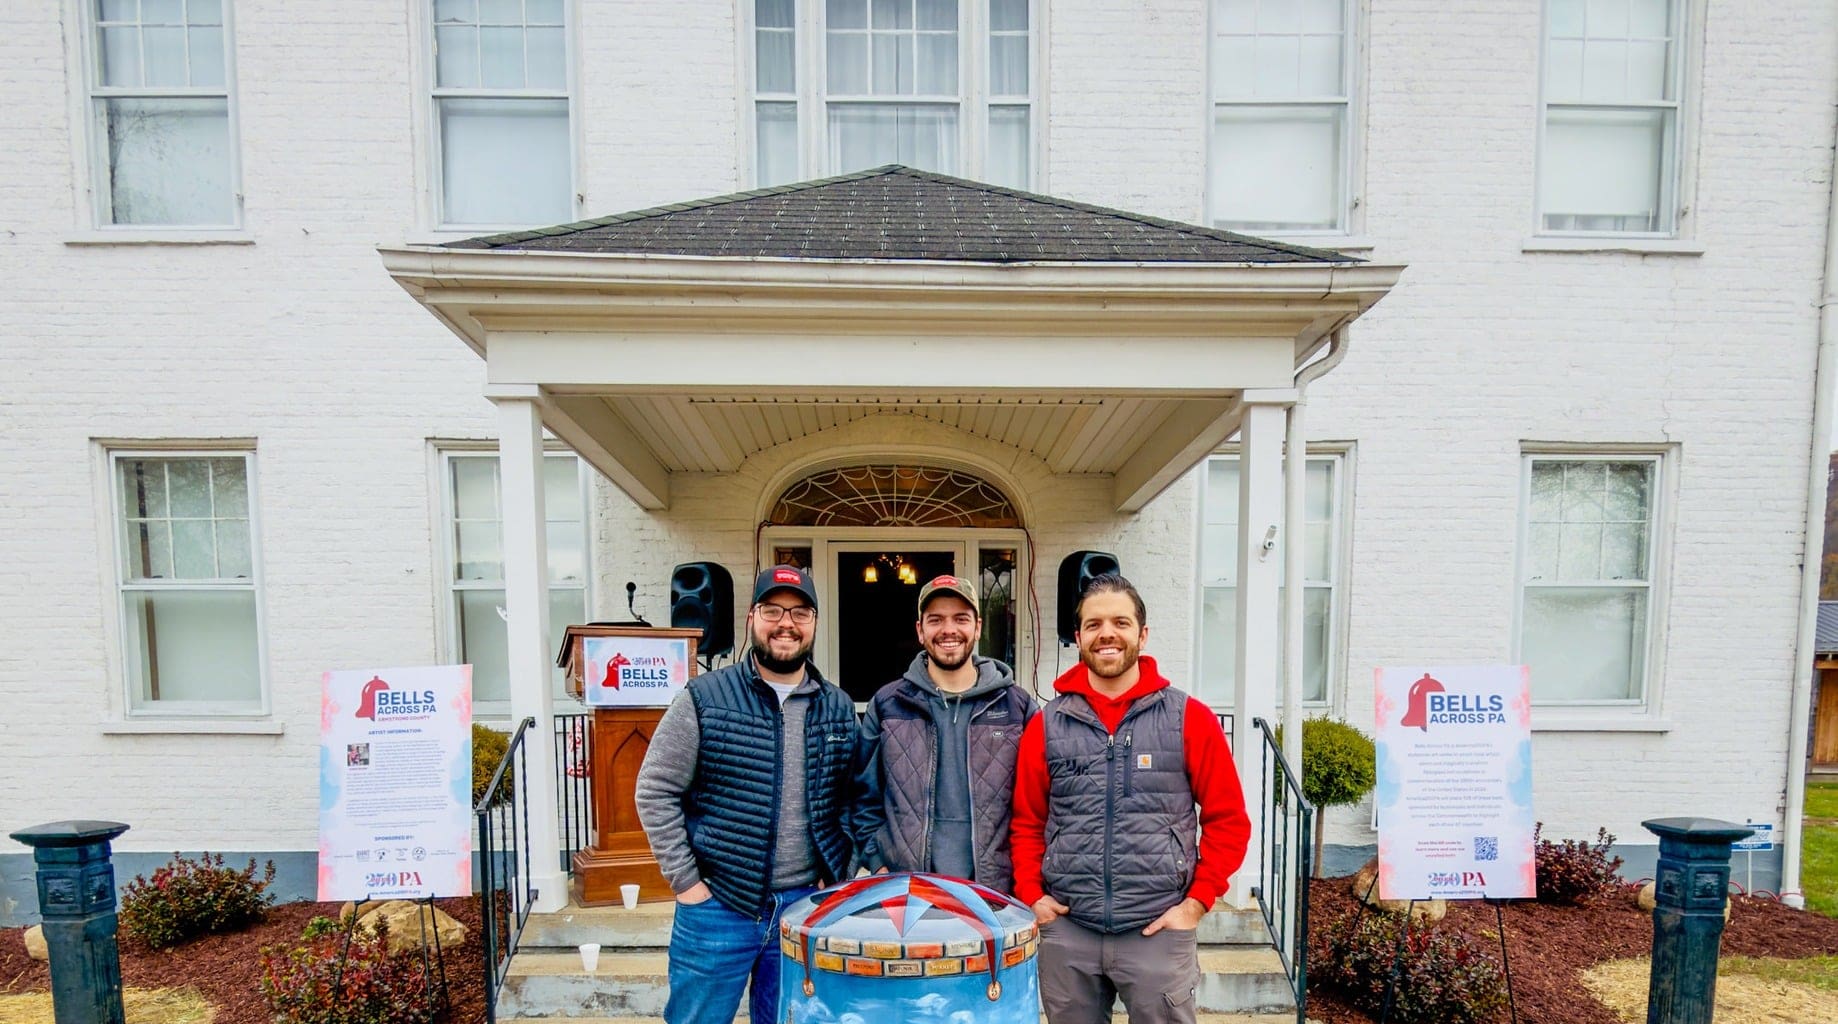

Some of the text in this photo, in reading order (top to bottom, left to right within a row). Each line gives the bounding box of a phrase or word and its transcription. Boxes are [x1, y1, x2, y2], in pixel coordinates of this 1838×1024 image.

[622, 668, 668, 680] BELLS
[378, 690, 434, 706] BELLS
[1430, 695, 1503, 712] BELLS
[378, 705, 436, 715] ACROSS PA
[1430, 713, 1506, 724] ACROSS PA
